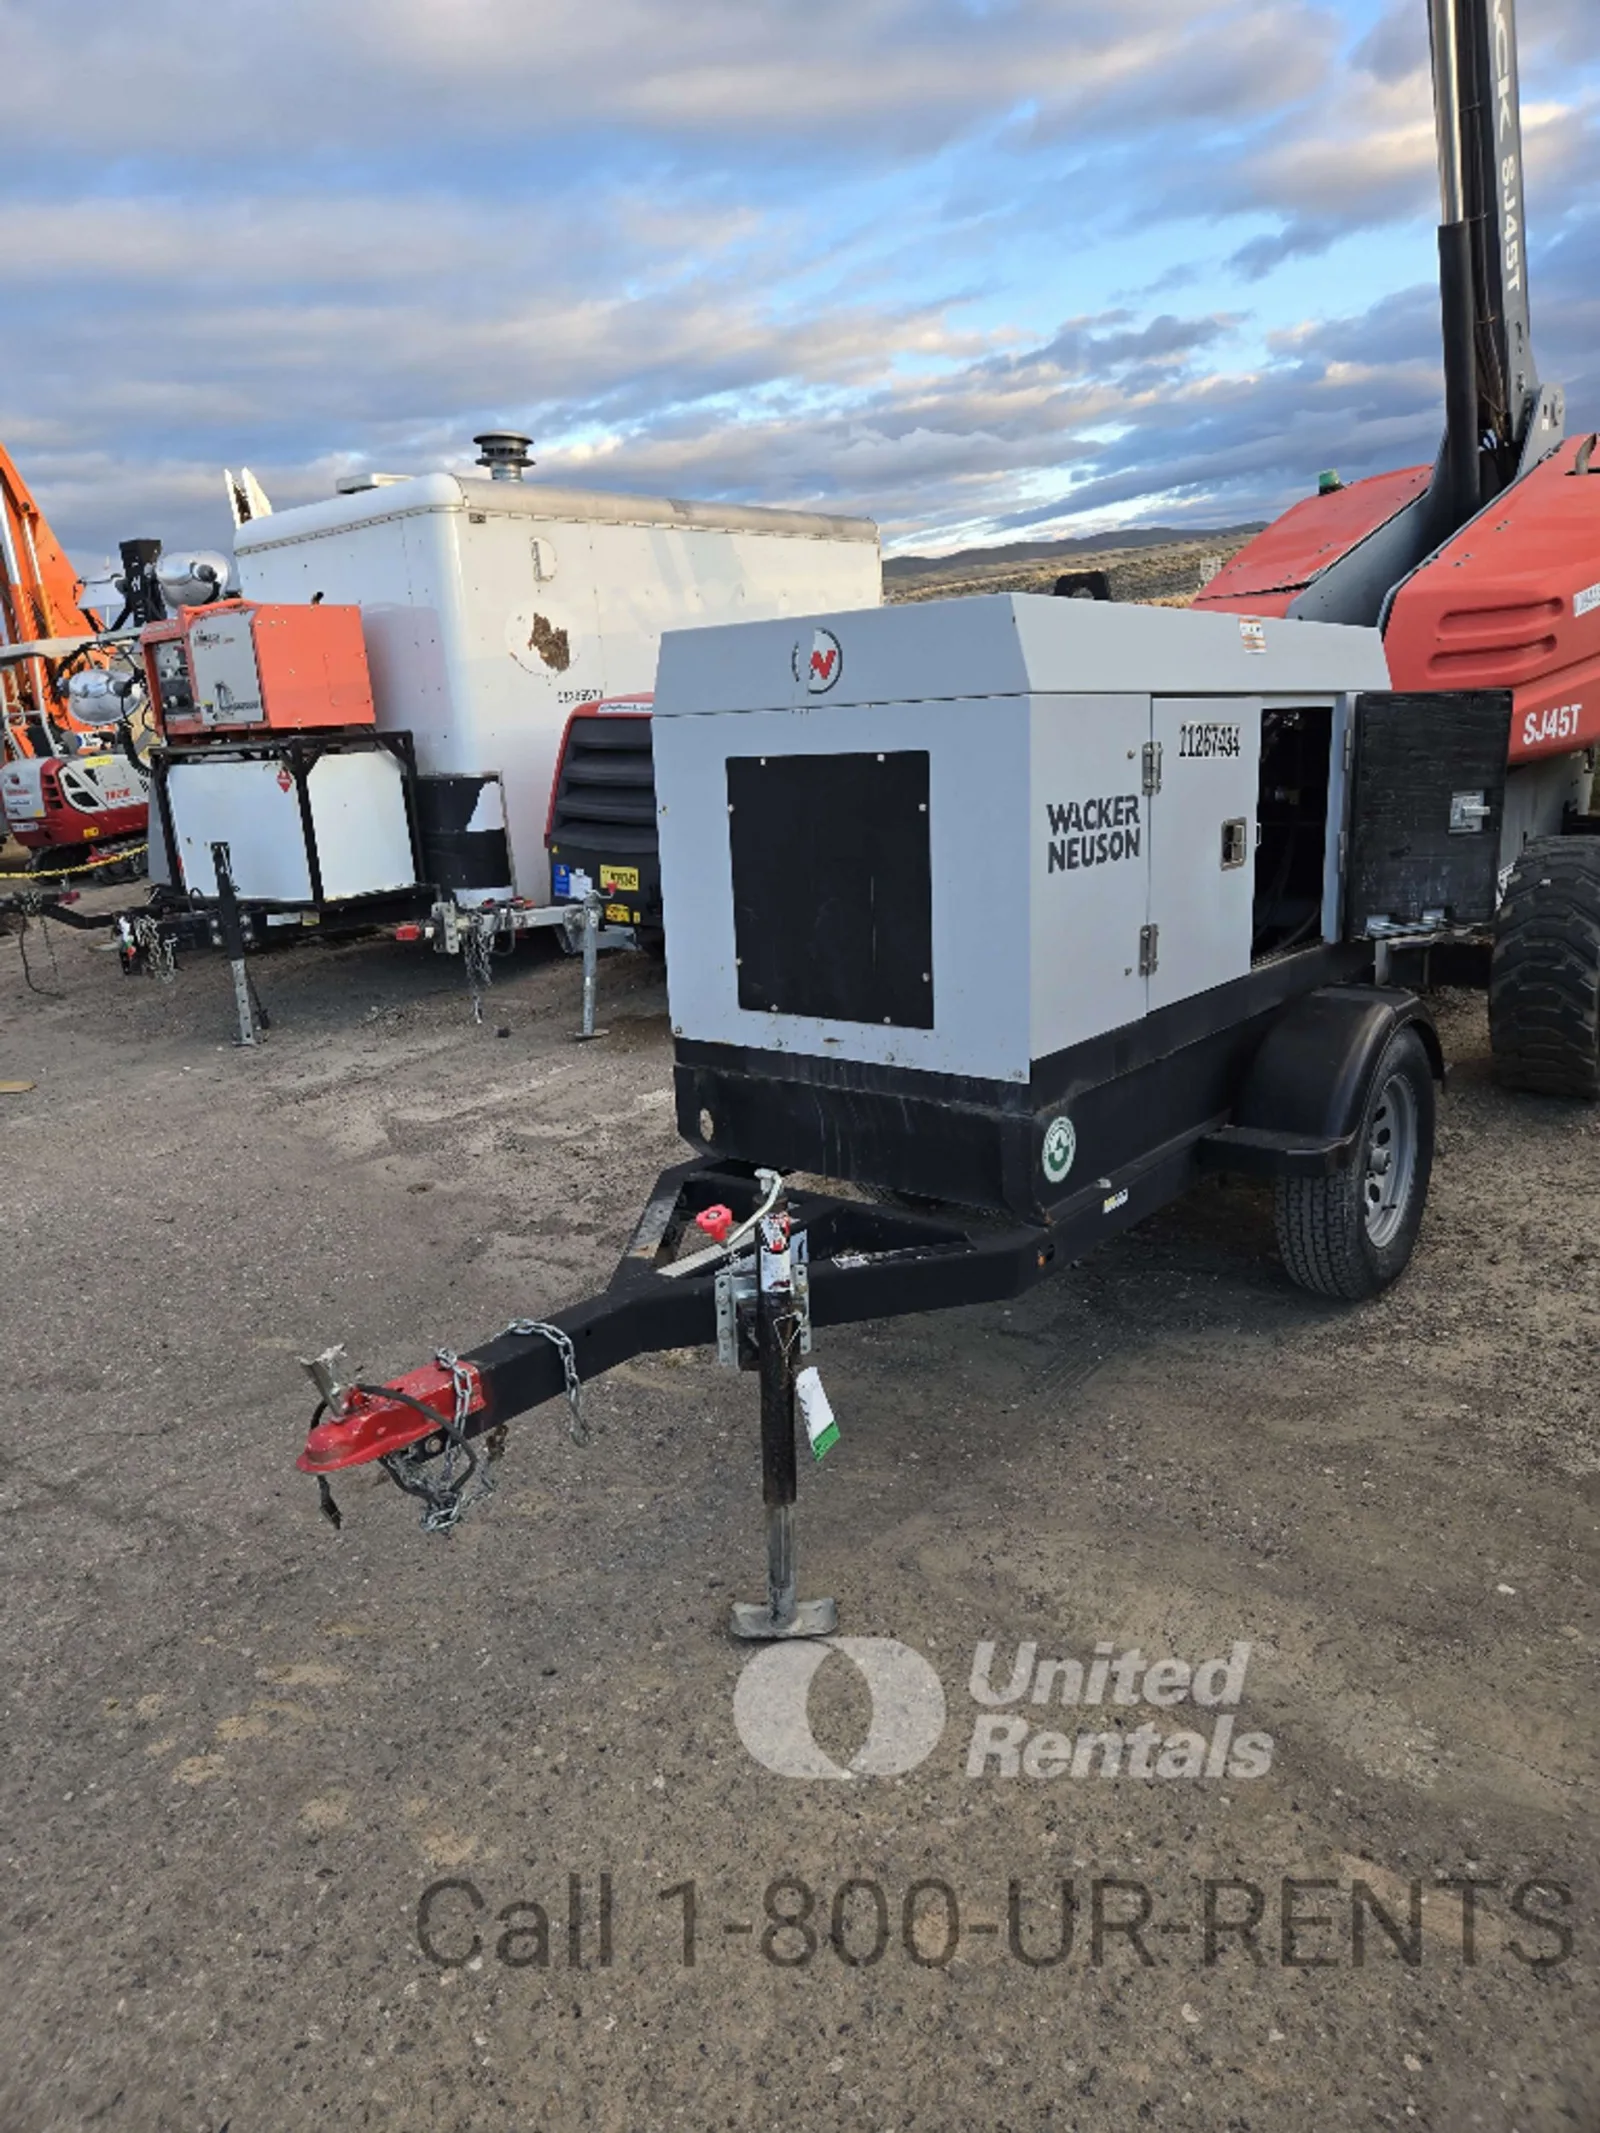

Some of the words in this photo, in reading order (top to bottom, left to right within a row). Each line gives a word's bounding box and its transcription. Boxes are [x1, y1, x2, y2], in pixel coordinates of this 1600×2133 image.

[1501, 153, 1521, 292] SJ45T
[1523, 703, 1583, 745] SJ45T
[1046, 794, 1140, 836] WACKER
[1048, 827, 1140, 874] NEUSON
